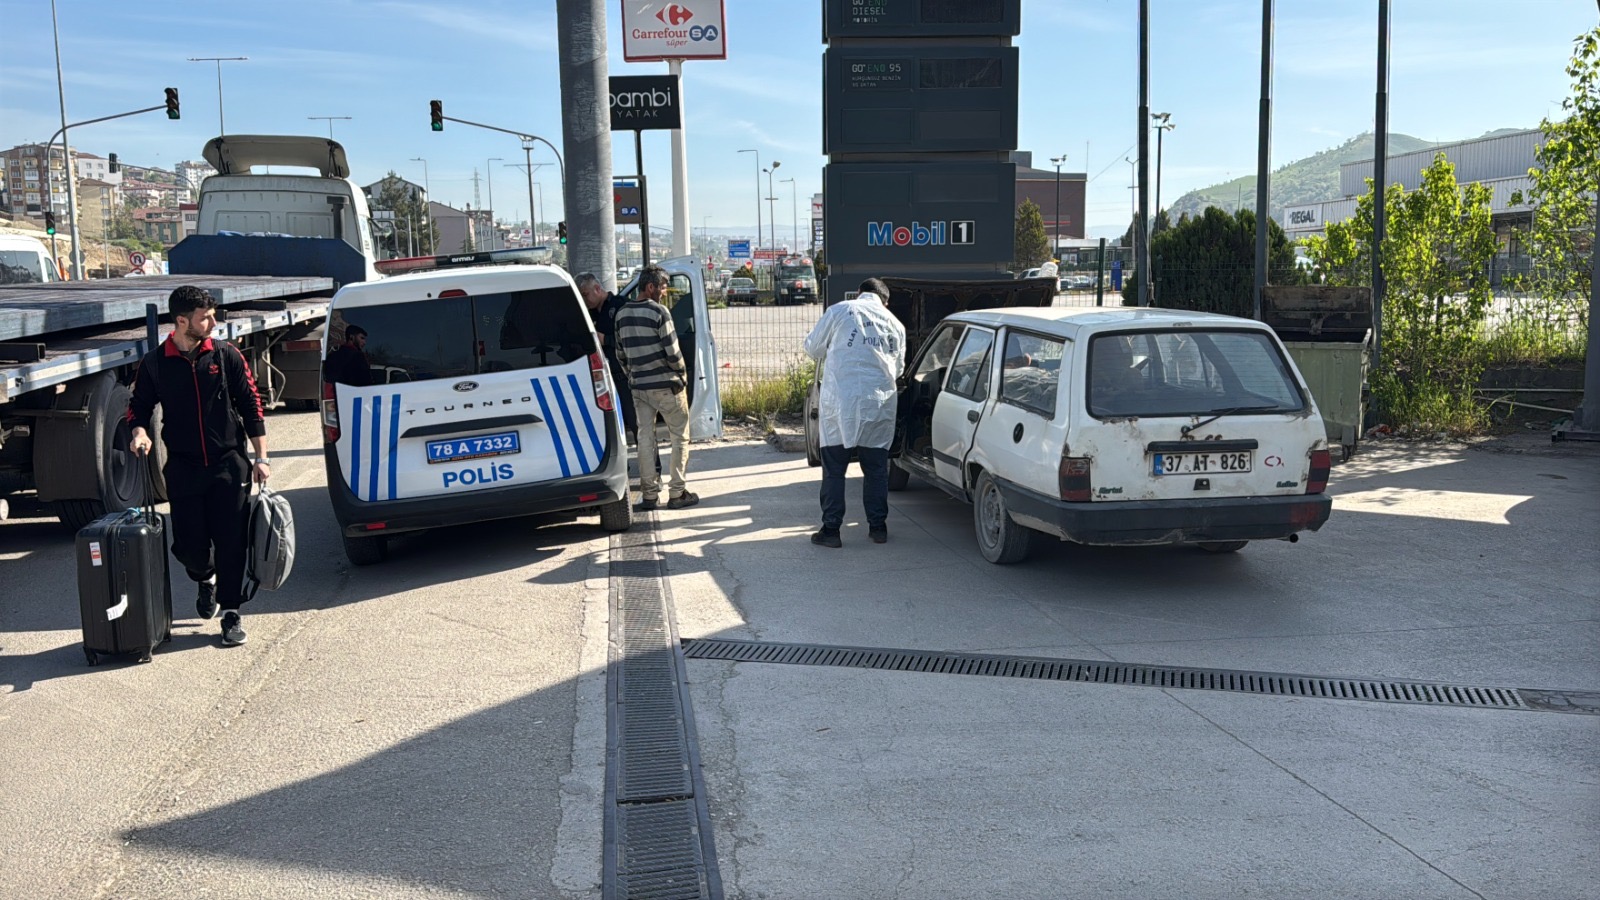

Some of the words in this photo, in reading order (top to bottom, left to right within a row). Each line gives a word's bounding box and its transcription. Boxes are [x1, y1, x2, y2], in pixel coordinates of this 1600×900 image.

[852, 7, 887, 15] DIESEL
[632, 27, 688, 40] Carrefour
[666, 39, 688, 48] süper
[889, 63, 902, 73] 95
[616, 109, 659, 119] YATAK
[1291, 210, 1315, 224] REGAL
[868, 221, 946, 246] Mobil
[847, 328, 858, 348] OLAY
[456, 382, 475, 391] Ford
[406, 396, 531, 415] TOURNEO
[433, 443, 454, 457] 78
[458, 442, 470, 454] A
[473, 436, 513, 452] 7332
[1165, 455, 1183, 472] 37
[1192, 454, 1210, 471] AT
[1220, 453, 1247, 471] 826
[442, 461, 514, 488] POLİS
